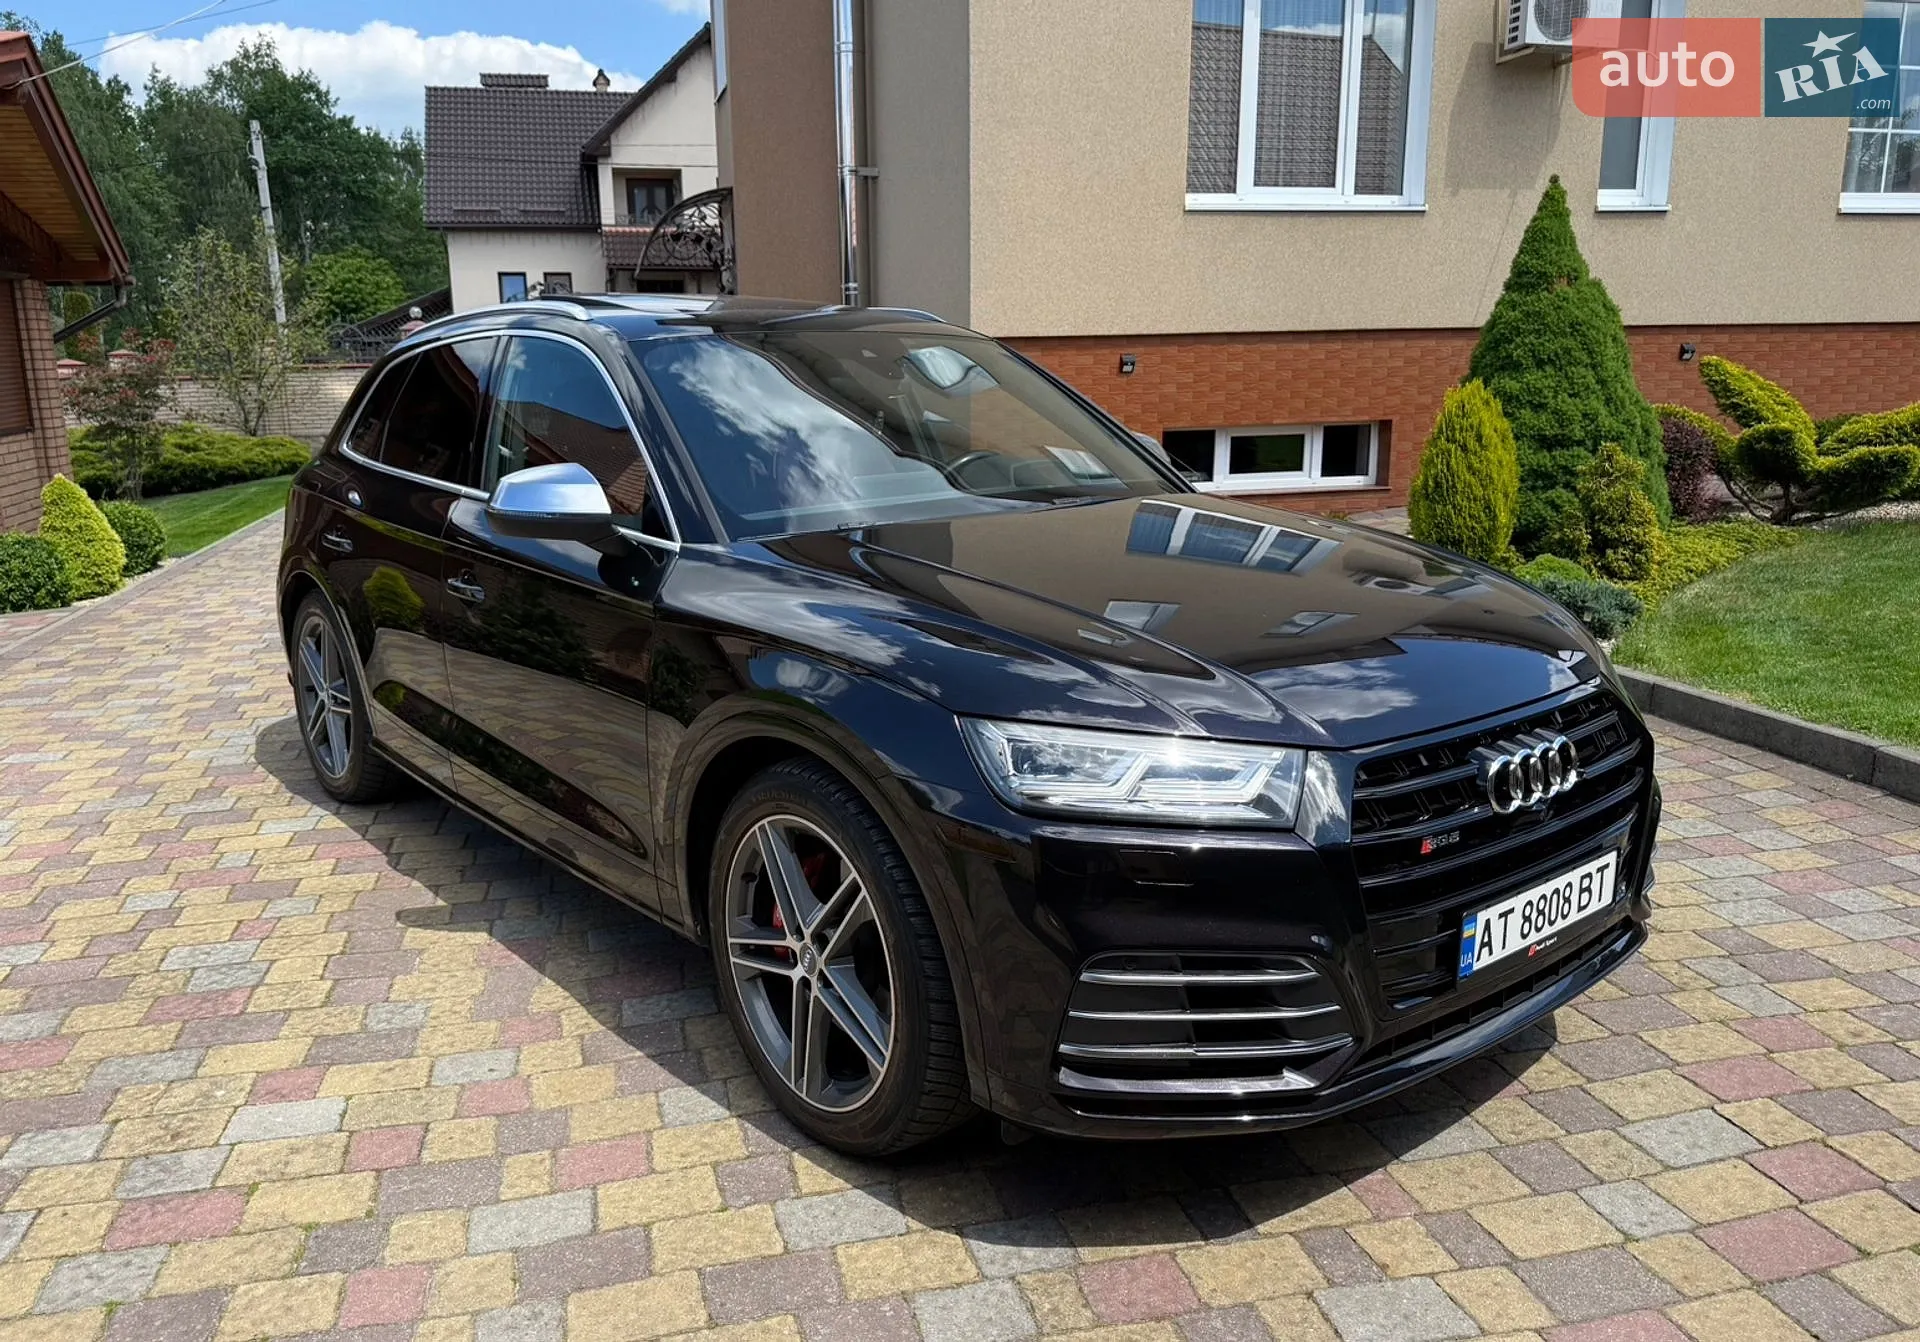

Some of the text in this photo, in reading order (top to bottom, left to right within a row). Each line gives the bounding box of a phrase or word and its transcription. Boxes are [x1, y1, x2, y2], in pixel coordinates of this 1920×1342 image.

[1475, 862, 1610, 963] AT 8808 BT
[1460, 952, 1473, 967] UA
